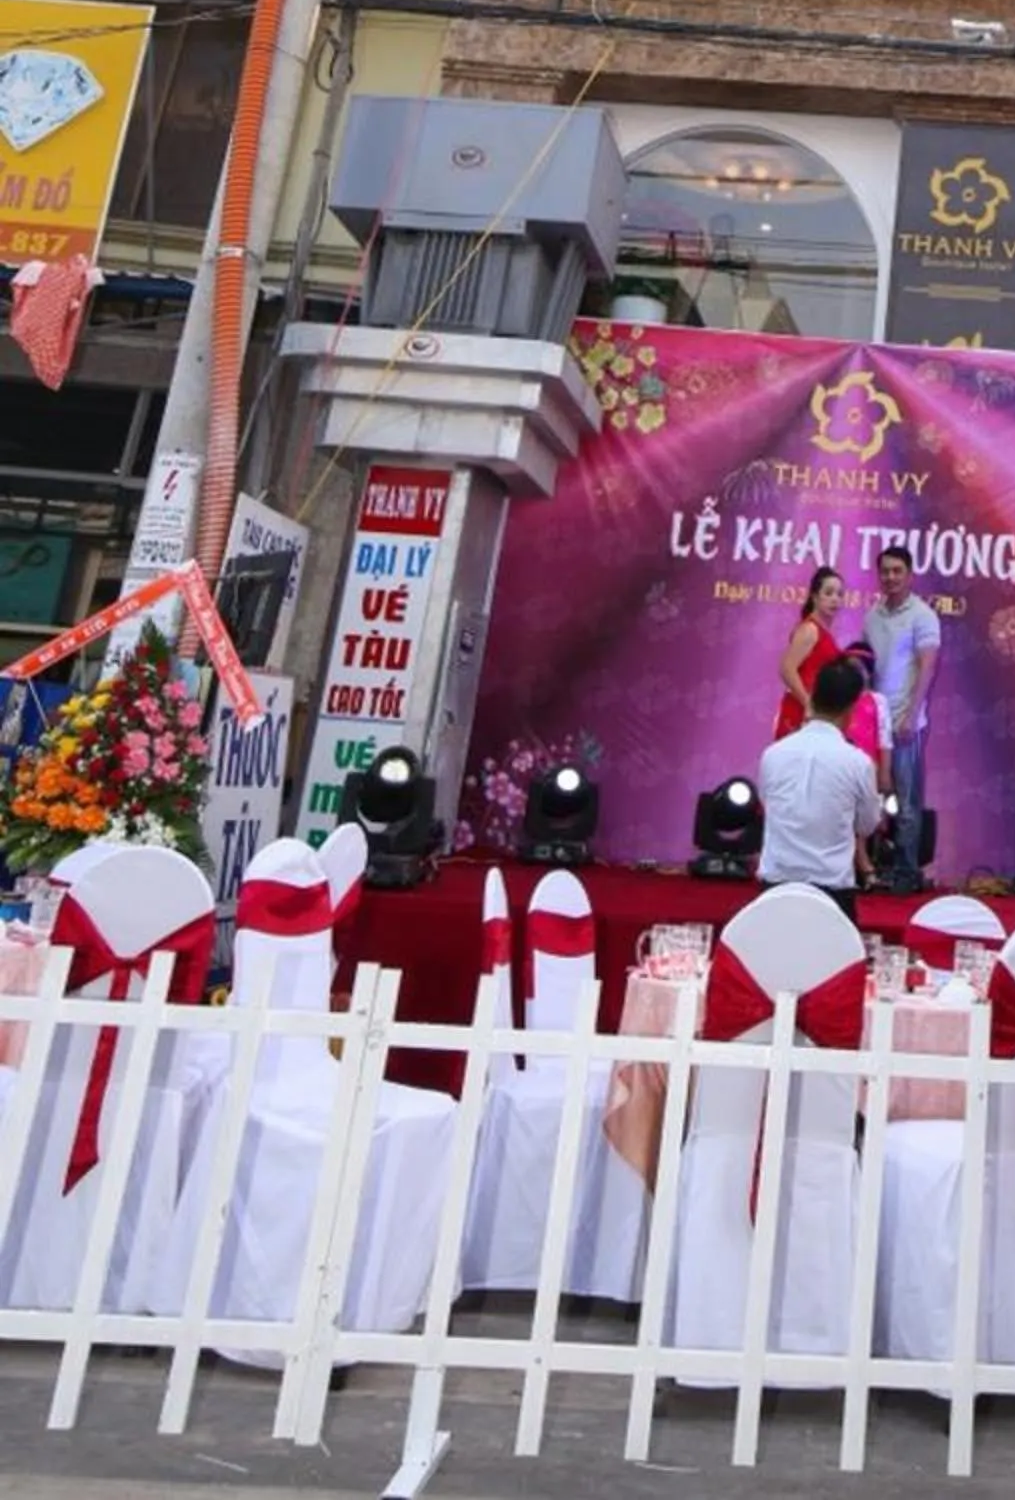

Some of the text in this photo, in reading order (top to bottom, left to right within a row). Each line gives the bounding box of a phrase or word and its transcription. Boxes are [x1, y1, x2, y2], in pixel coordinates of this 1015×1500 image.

[898, 233, 992, 258] THANH
[774, 462, 930, 496] THANH VY
[671, 496, 721, 560] LỄ
[732, 516, 841, 567] KHAI
[355, 541, 431, 581] ĐẠI LÝ
[361, 584, 409, 622] VÉ
[343, 630, 412, 670] TÀU
[326, 678, 405, 718] CAO TỐC
[335, 735, 377, 770] VÉ
